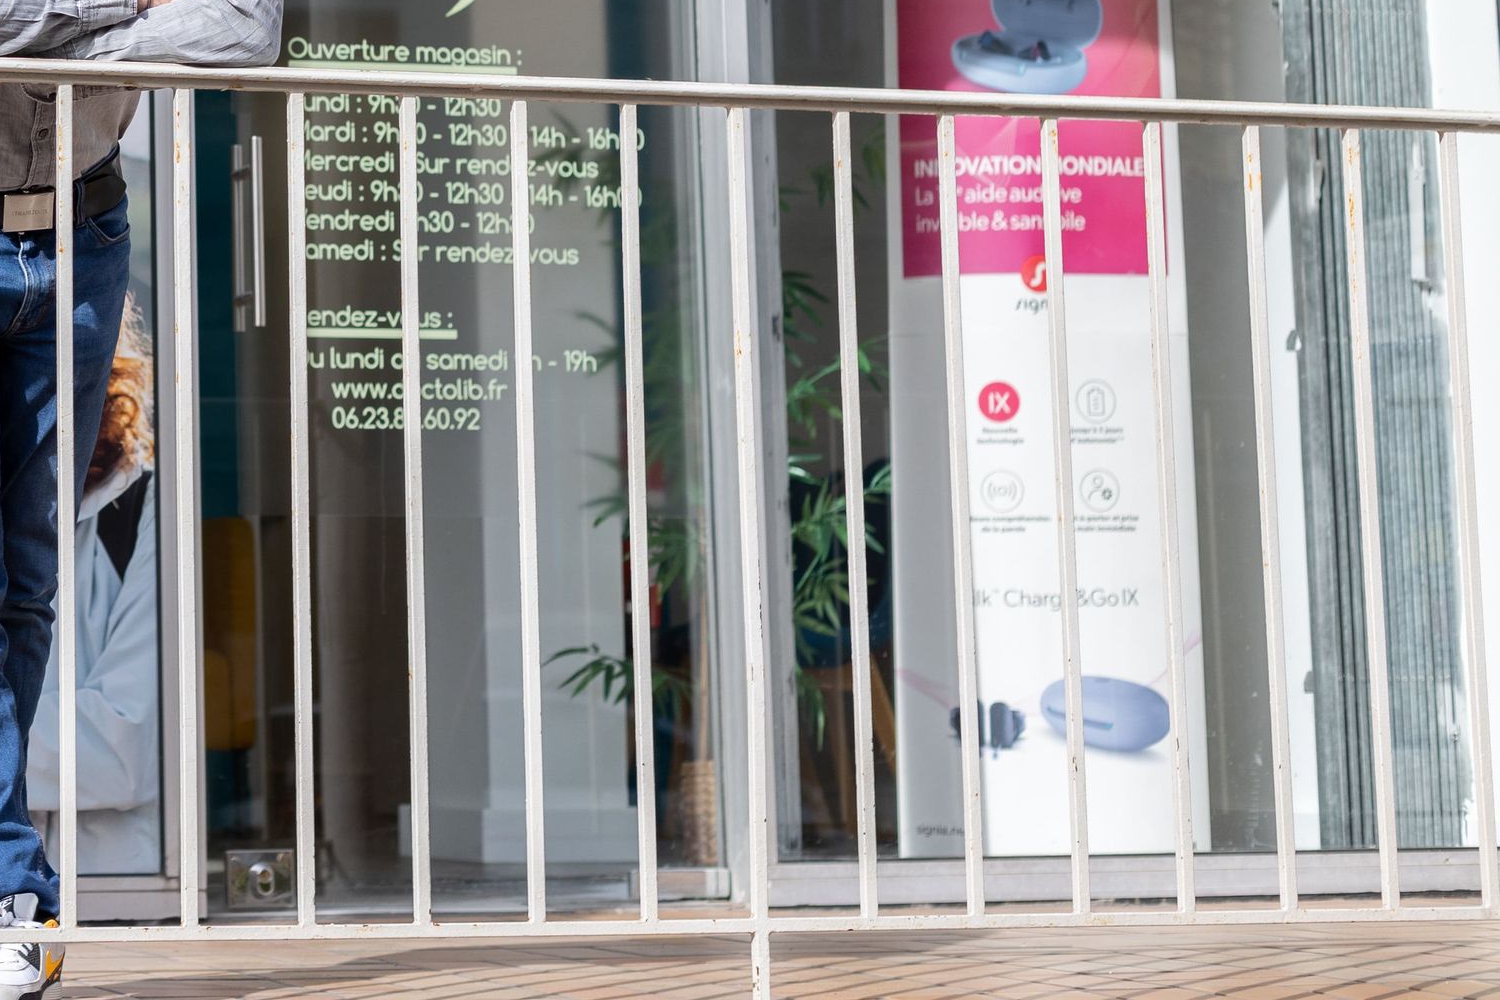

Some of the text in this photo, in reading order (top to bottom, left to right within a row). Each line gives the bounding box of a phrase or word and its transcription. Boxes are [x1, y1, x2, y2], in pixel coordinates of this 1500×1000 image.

[287, 36, 410, 62] Ouverture
[415, 44, 512, 68] magasin
[303, 94, 350, 113] undi
[444, 97, 501, 118] 12h30
[373, 121, 427, 145] 9h0
[448, 123, 507, 147] 12h30
[530, 125, 566, 149] 14h
[586, 127, 645, 151] 16h0
[416, 152, 451, 175] Sur
[456, 154, 600, 179] rendz-vous
[1059, 155, 1145, 177] ONDIALE
[304, 179, 353, 202] eudi
[445, 181, 505, 205] 12h30
[528, 183, 563, 207] 14h
[915, 186, 934, 206] La
[964, 182, 1008, 204] aide
[1009, 185, 1082, 204] audve
[304, 208, 395, 232] endredi
[417, 210, 455, 233] h30
[476, 211, 535, 235] 12h
[915, 211, 990, 233] invble
[991, 209, 1008, 232] &
[1010, 213, 1044, 231] san
[305, 238, 374, 261] amedi
[392, 239, 430, 263] Sr
[435, 241, 580, 265] rendezvous
[307, 304, 442, 328] endez-vus
[329, 346, 385, 369] lundi
[425, 348, 508, 371] samedi
[563, 350, 598, 372] 19h
[330, 377, 508, 401] www.dctolib.fr
[988, 391, 1011, 414] IX
[331, 405, 481, 430] 06.23.8.60.92
[1004, 588, 1119, 612] Charg&Go
